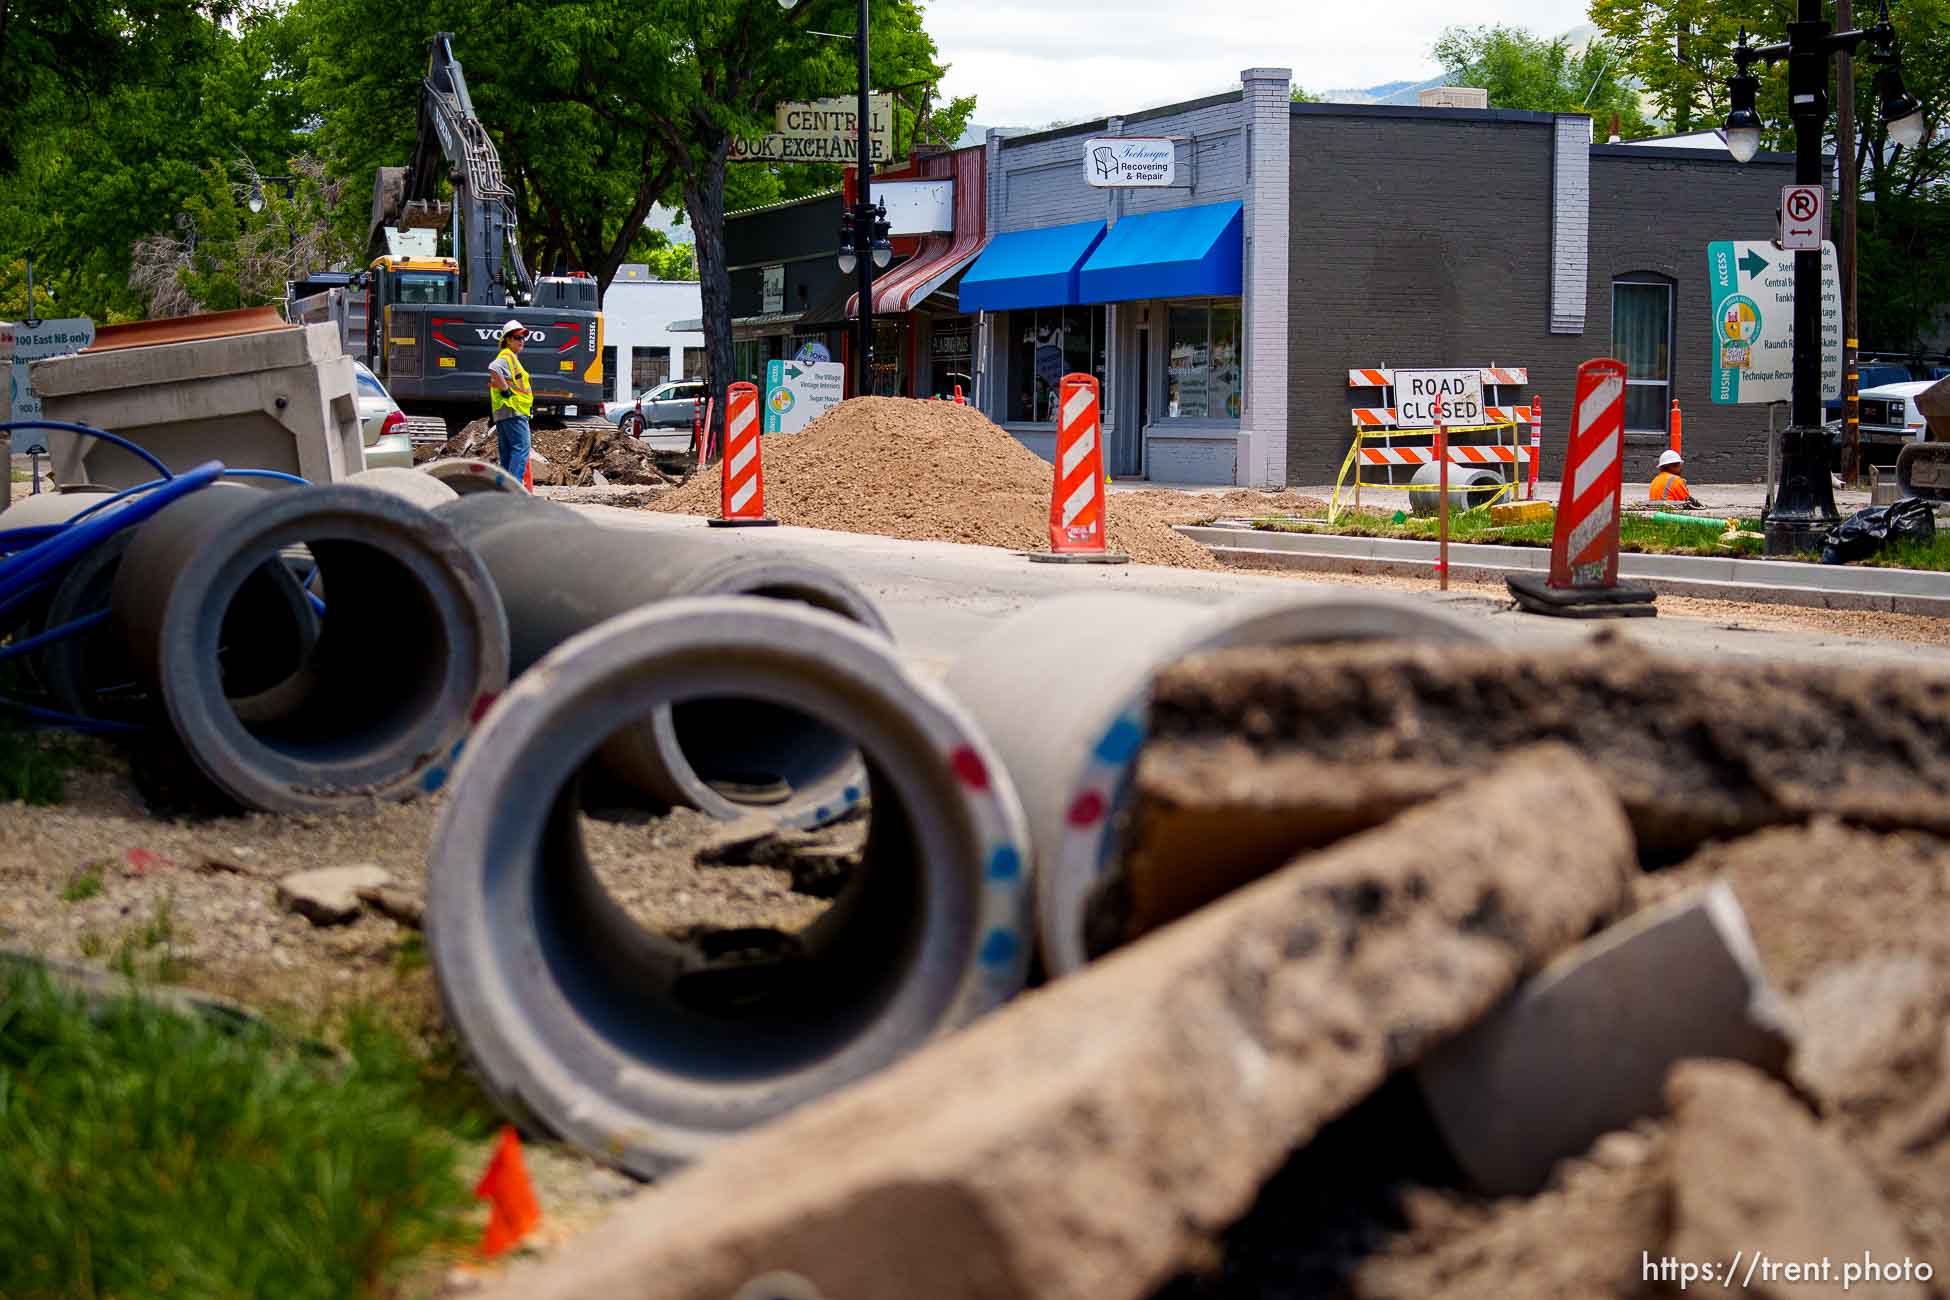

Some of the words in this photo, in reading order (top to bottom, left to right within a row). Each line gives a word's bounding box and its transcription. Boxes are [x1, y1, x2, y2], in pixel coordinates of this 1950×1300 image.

[787, 111, 885, 133] CENTRL
[735, 136, 776, 156] OOK
[782, 137, 883, 159] EXCHANE
[1121, 162, 1168, 172] Recovering
[1136, 172, 1163, 182] Repair
[1717, 251, 1729, 287] ACCESS
[1778, 262, 1793, 272] Sterl
[1764, 278, 1787, 288] Central
[1775, 293, 1793, 303] Fankh
[1823, 292, 1836, 303] elry
[1822, 308, 1837, 319] tage
[33, 334, 53, 345] East
[54, 334, 68, 344] NB
[70, 332, 89, 345] only
[475, 328, 546, 342] VOVO
[1764, 339, 1787, 349] Raunch
[824, 374, 841, 382] Village
[1742, 370, 1774, 382] Technique
[1774, 369, 1793, 380] Recov
[1412, 378, 1465, 396] ROAD
[1720, 370, 1731, 400] BUSIN
[1822, 383, 1836, 393] Plus
[1403, 402, 1477, 419] CLOSED
